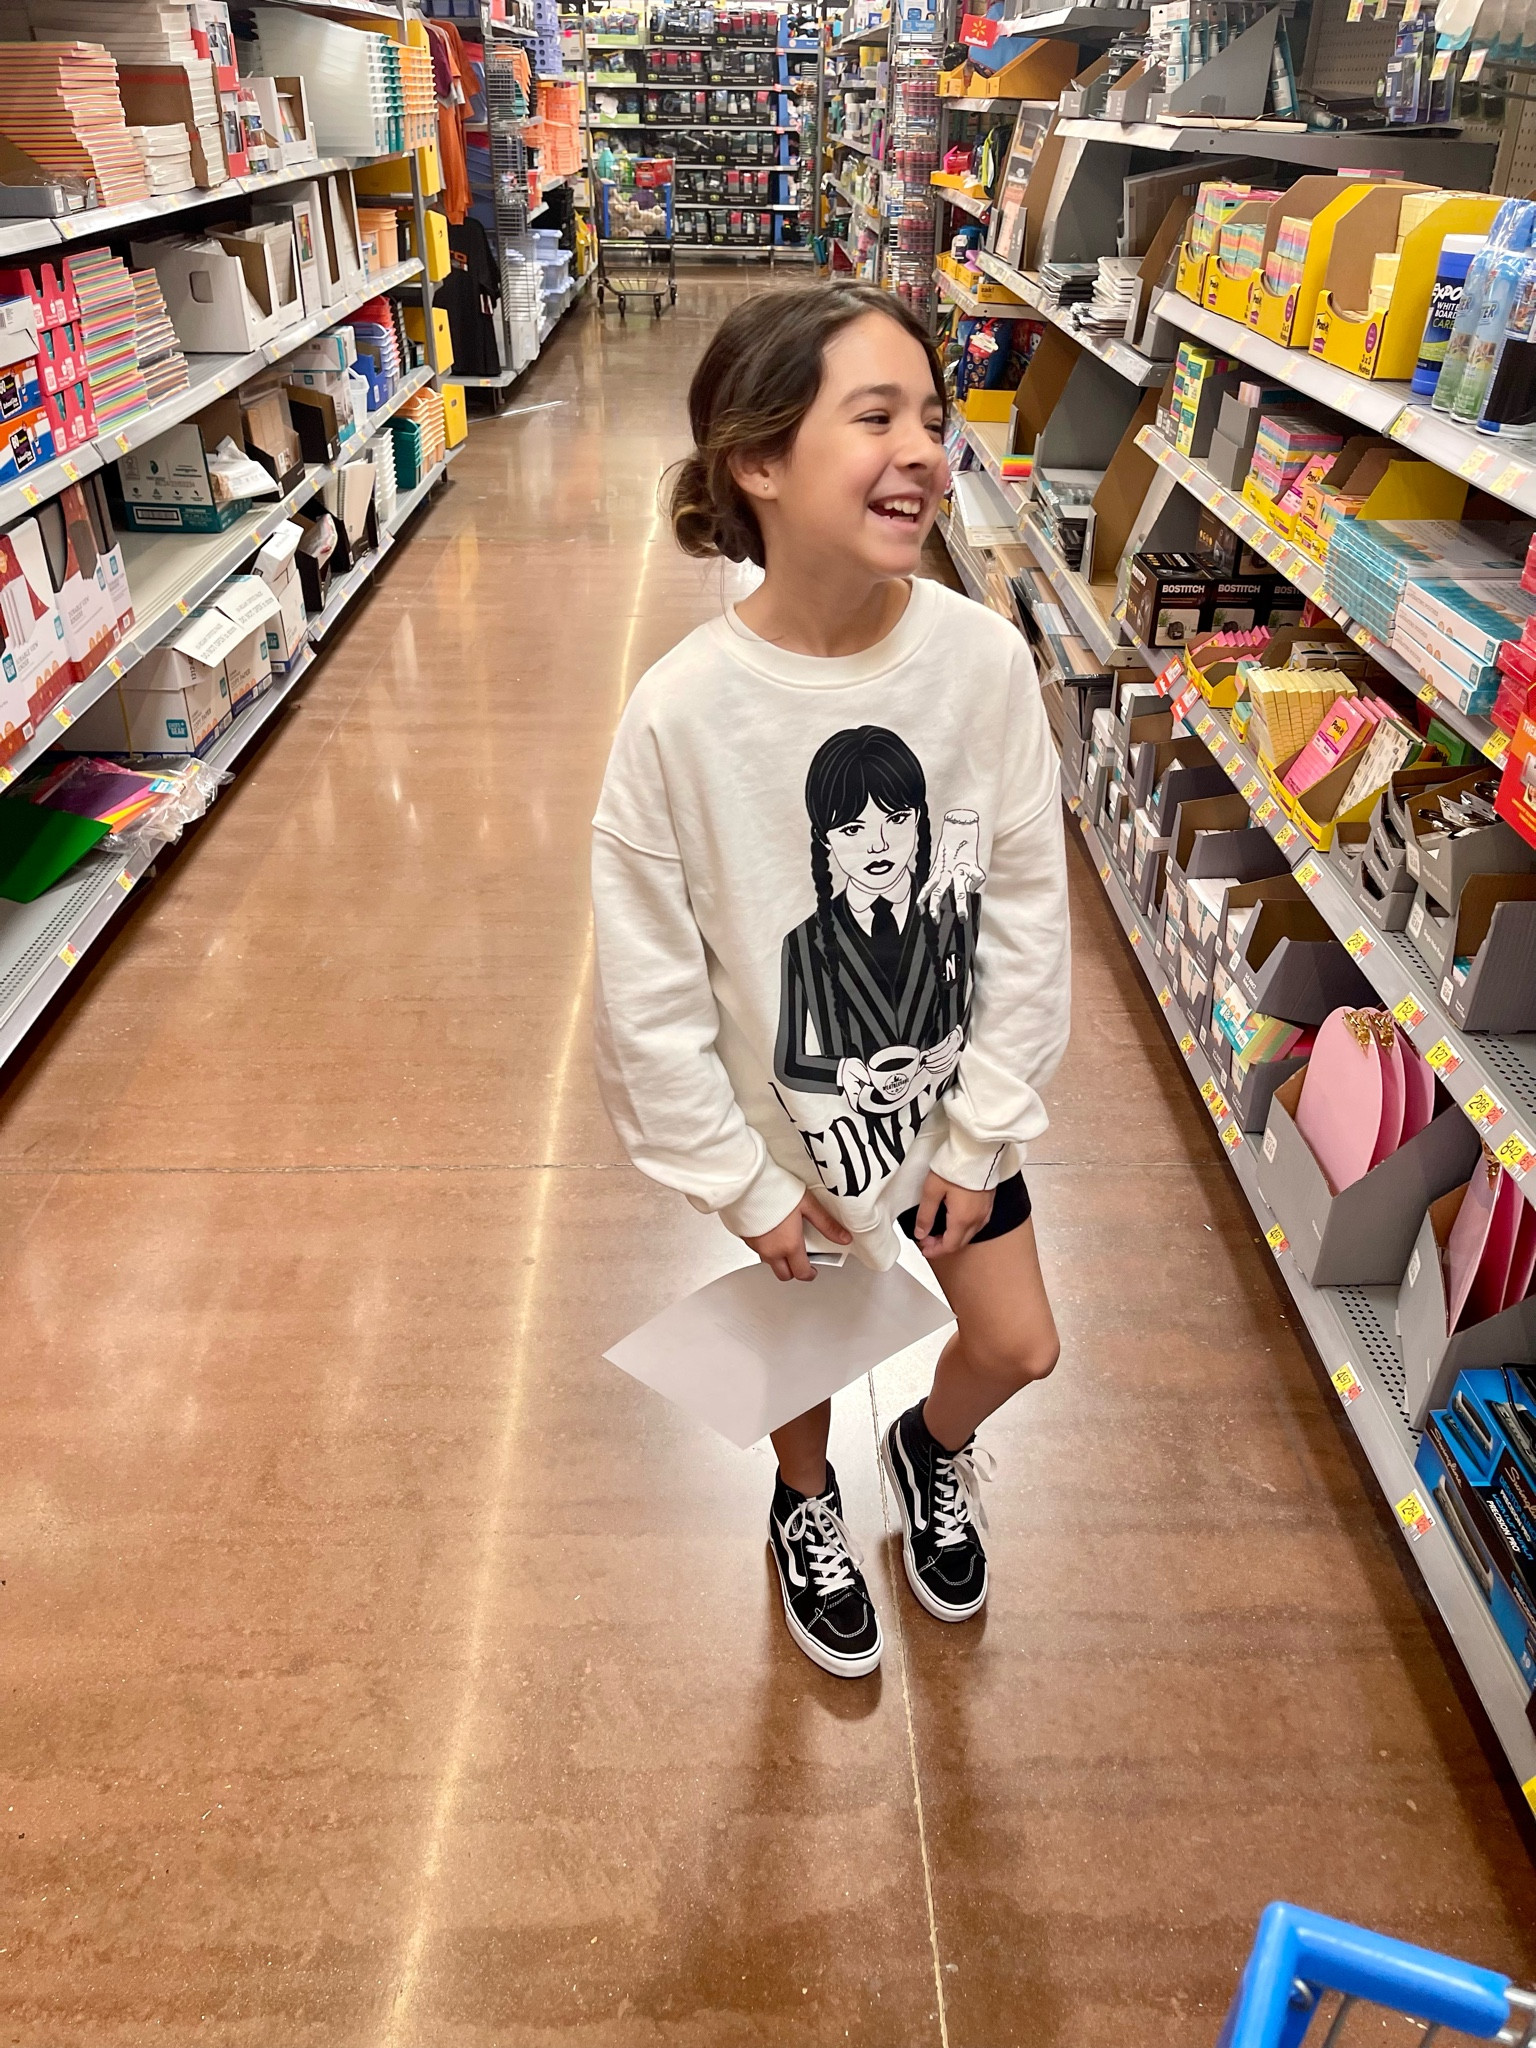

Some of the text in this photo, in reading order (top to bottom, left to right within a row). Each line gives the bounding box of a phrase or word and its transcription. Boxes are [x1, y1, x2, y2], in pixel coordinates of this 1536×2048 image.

[1431, 282, 1463, 304] EXPO
[1162, 584, 1205, 594] BOSTITCH
[1217, 584, 1261, 594] BOSTITCH
[945, 953, 956, 982] N
[1430, 1045, 1448, 1064] 127
[1468, 1093, 1490, 1114] 286
[1500, 1138, 1522, 1160] 842
[1334, 1371, 1352, 1388] 497
[1430, 1427, 1462, 1489] Swingline
[1486, 1500, 1512, 1536] PRECISION
[1506, 1536, 1521, 1553] PRO
